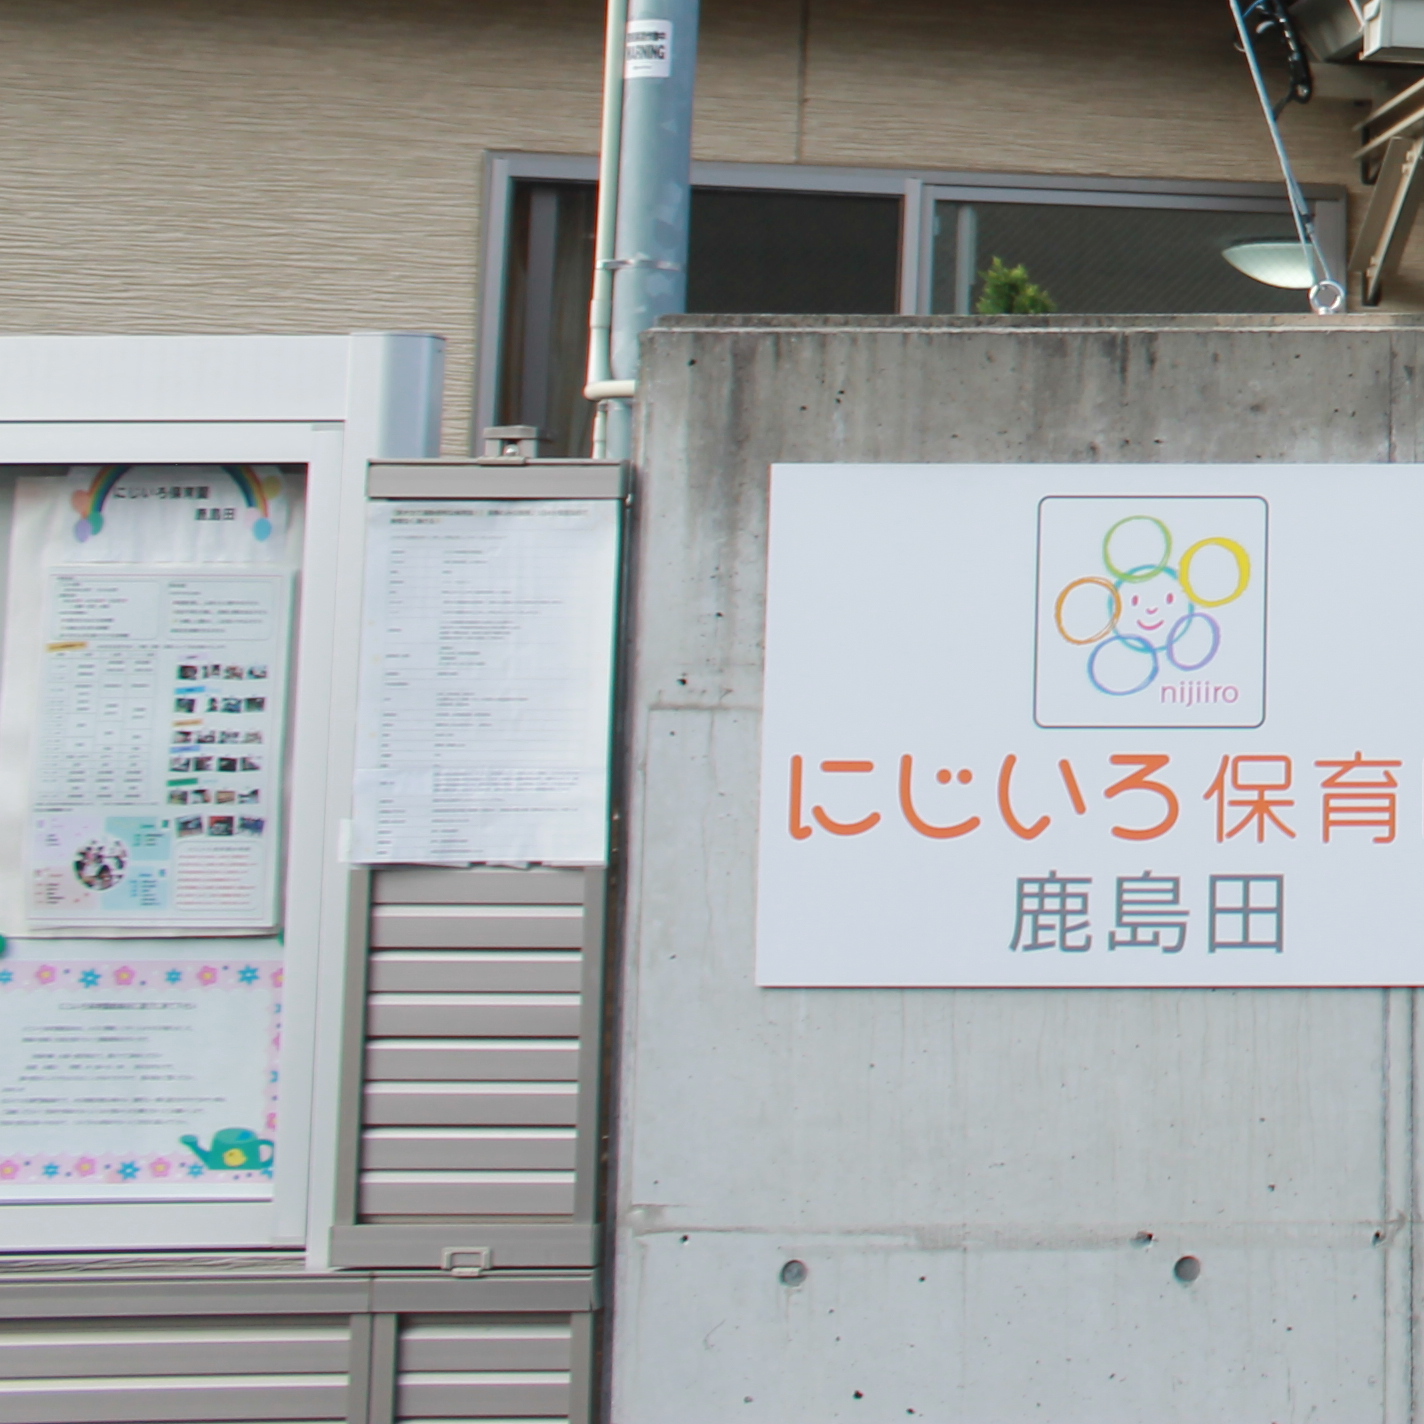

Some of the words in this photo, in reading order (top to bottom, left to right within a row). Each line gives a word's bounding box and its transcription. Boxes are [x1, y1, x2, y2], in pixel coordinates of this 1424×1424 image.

[1160, 679, 1239, 707] nijiiro
[1008, 869, 1285, 953] 鹿島田
